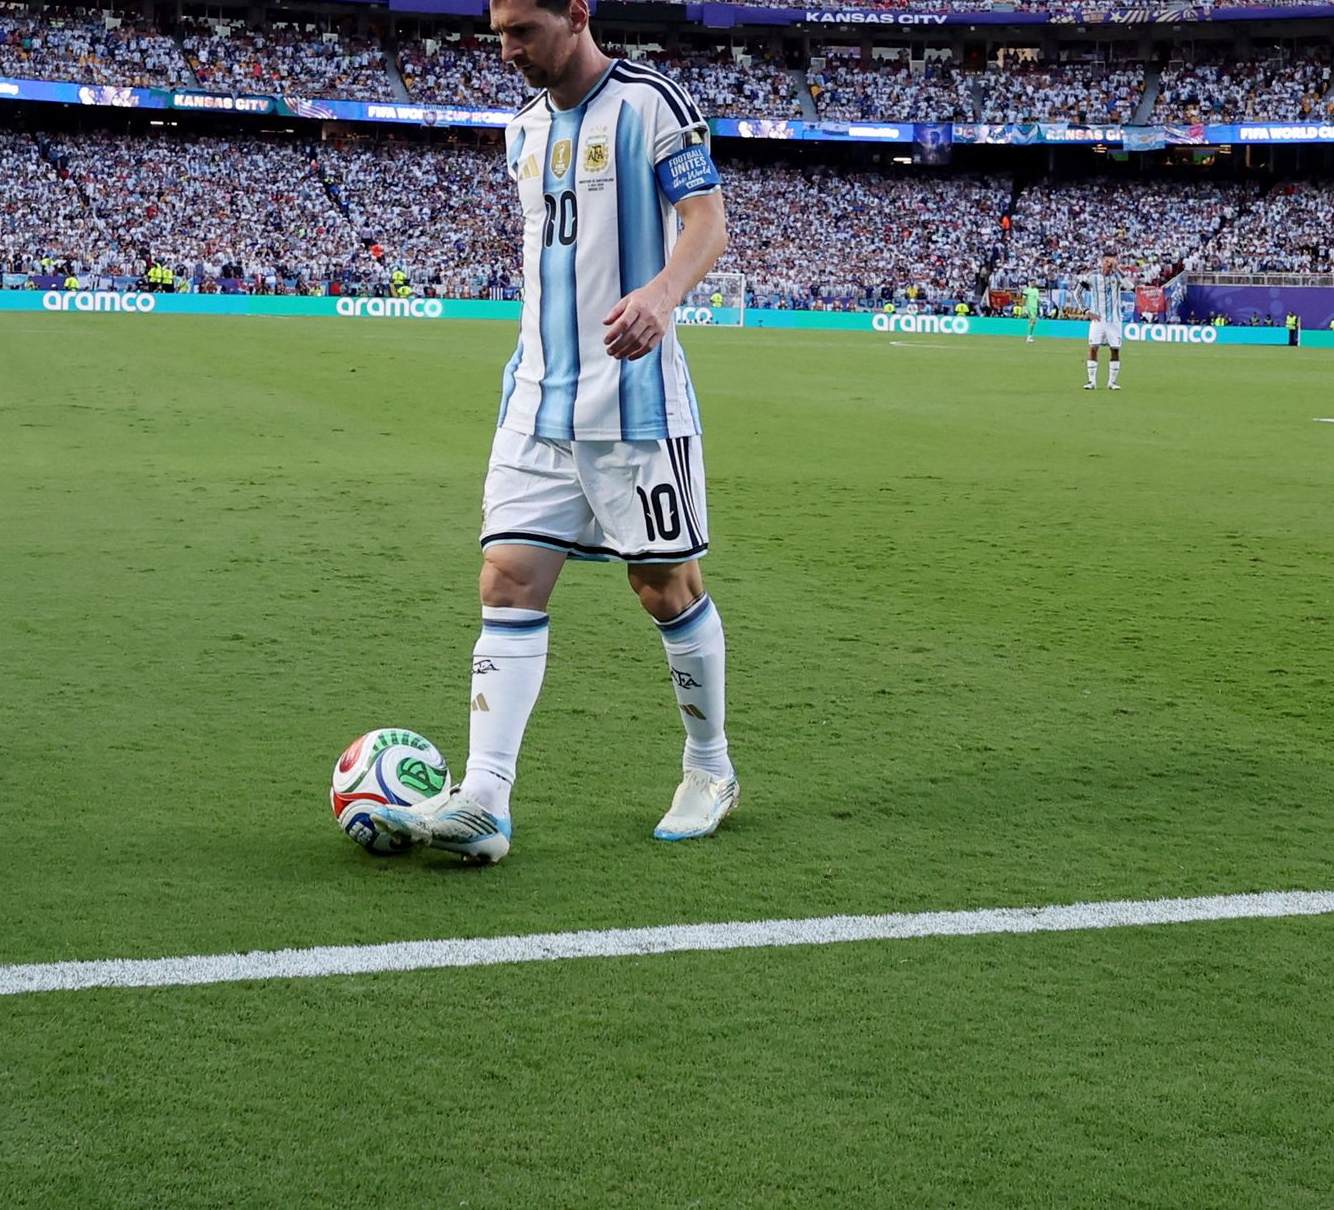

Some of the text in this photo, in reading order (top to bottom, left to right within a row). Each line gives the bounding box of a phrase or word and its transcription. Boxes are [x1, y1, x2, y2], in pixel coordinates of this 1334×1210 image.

[806, 12, 948, 24] KANSAS CITY
[174, 94, 268, 111] KANSAS CITY
[368, 106, 396, 118] FIFA
[1046, 129, 1103, 141] KANSAS
[1240, 127, 1269, 140] FIFA
[1269, 126, 1318, 139] WORLD
[668, 149, 703, 167] FOOTBALL
[670, 157, 707, 178] UNITES
[544, 190, 578, 247] 10
[43, 291, 155, 312] aramco
[336, 297, 443, 318] aramco
[872, 313, 969, 335] aramco
[1124, 323, 1217, 344] aramco
[636, 483, 682, 542] 10
